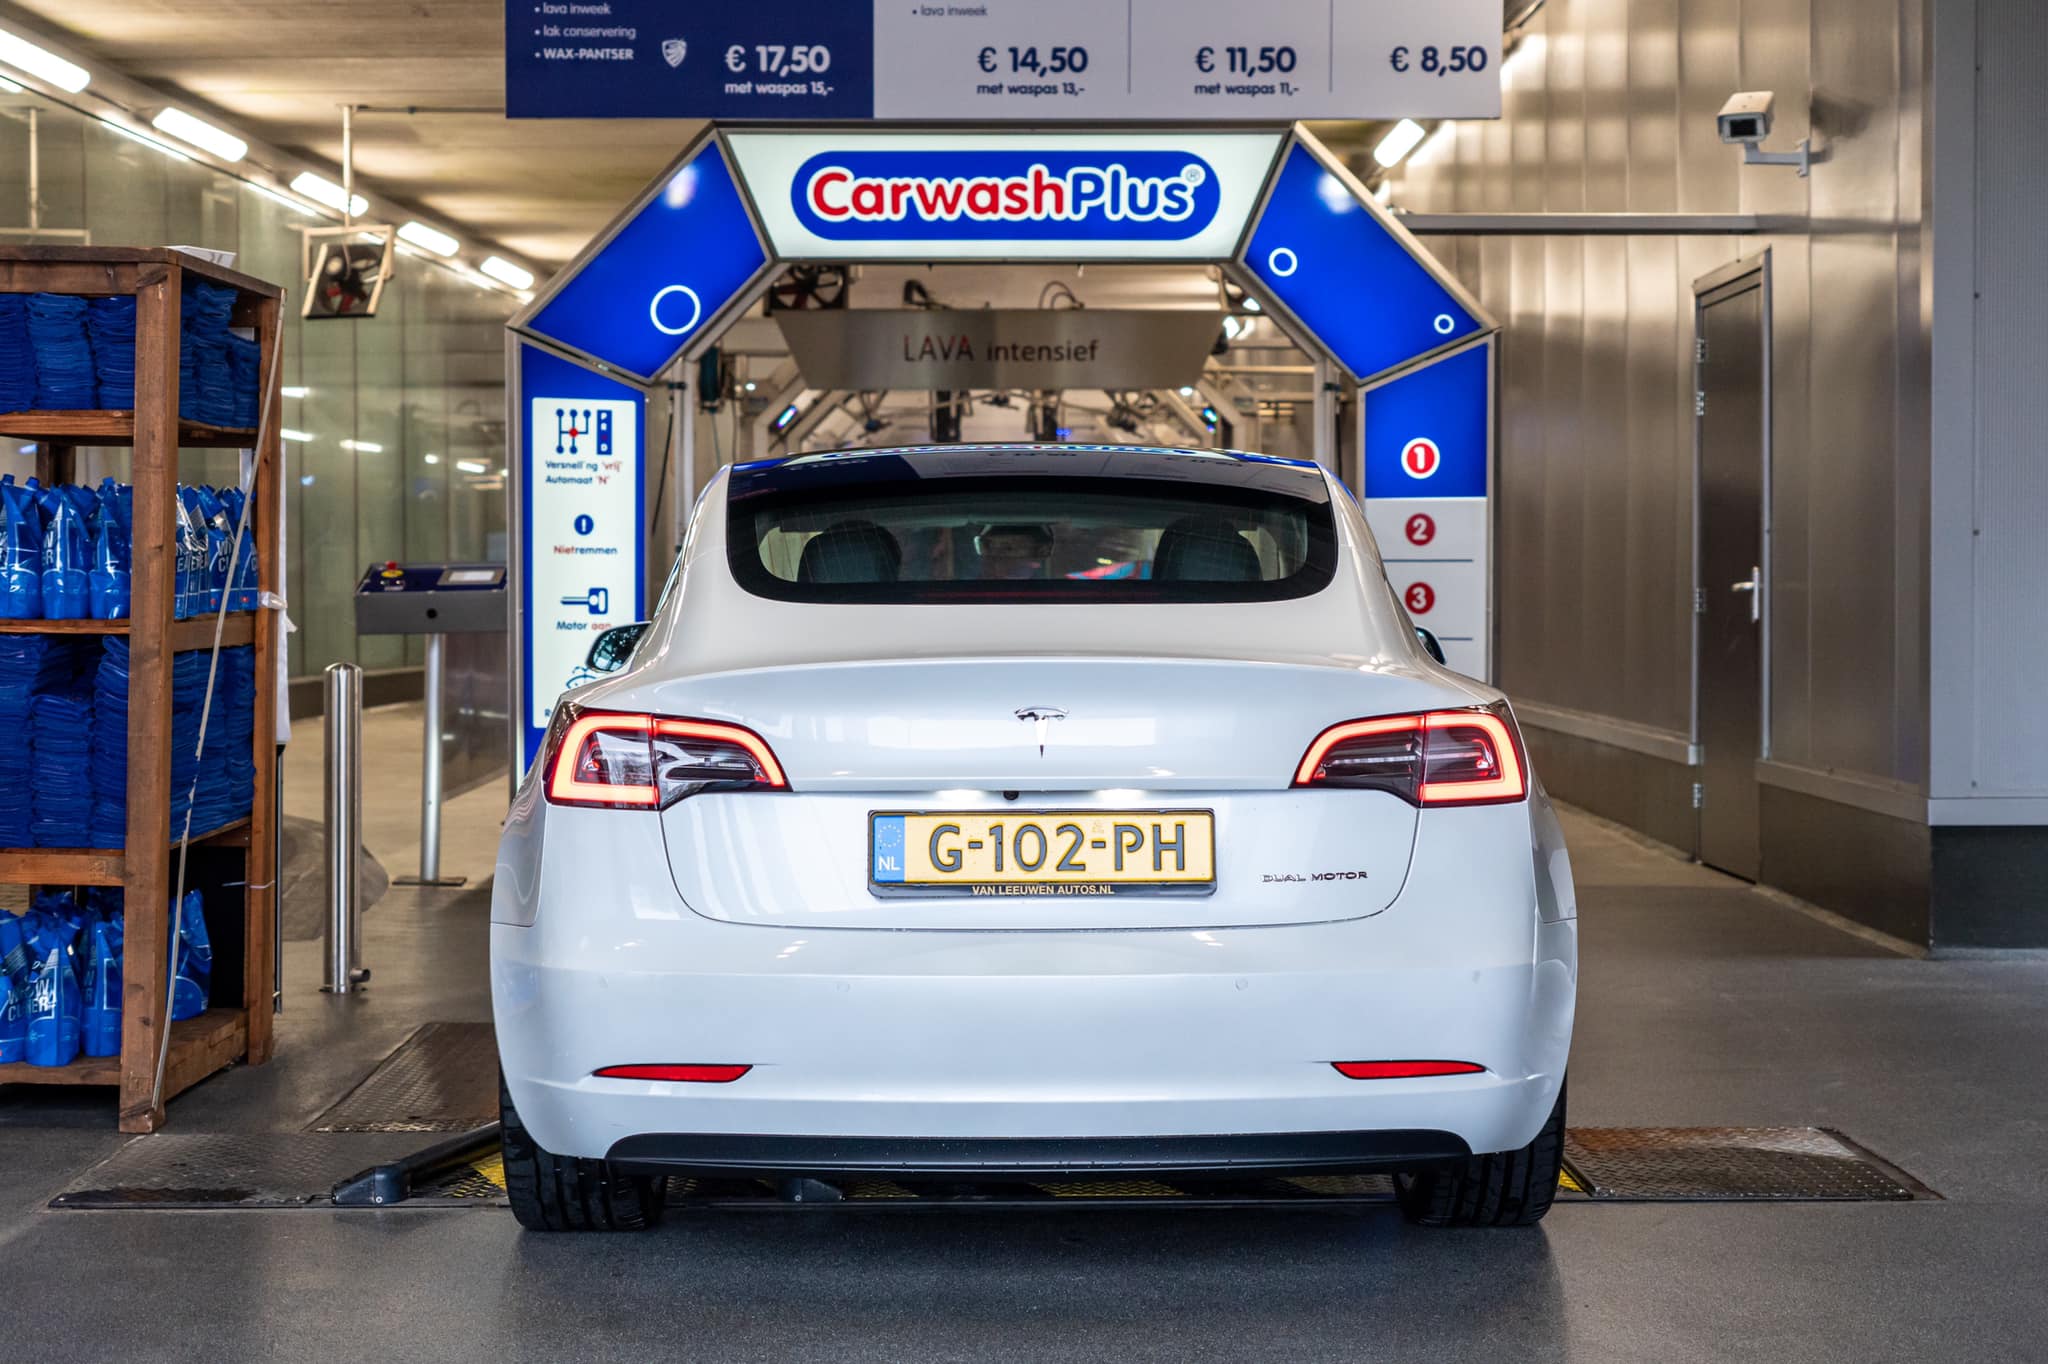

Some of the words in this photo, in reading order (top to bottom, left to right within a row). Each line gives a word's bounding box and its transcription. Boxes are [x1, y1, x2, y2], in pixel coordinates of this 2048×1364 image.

[543, 2, 568, 15] lava
[570, 2, 611, 15] inweek
[920, 5, 945, 17] lava
[948, 5, 988, 17] inweek
[543, 25, 560, 37] lak
[563, 26, 636, 40] conservering
[543, 48, 634, 60] WAX-PANTSER
[725, 45, 746, 73] €
[756, 45, 831, 77] 17,50
[977, 46, 998, 73] €
[1008, 46, 1089, 77] 14,50
[1195, 46, 1216, 73] €
[1226, 46, 1297, 77] 11,50
[1389, 46, 1410, 72] €
[1420, 46, 1488, 77] 8,50
[725, 81, 752, 94] met
[755, 83, 808, 97] waspas
[976, 83, 1004, 95] met
[1007, 84, 1058, 97] waspas
[1194, 82, 1221, 95] met
[1225, 84, 1276, 97] waspas
[903, 335, 975, 362] LAVA
[987, 340, 1099, 362] intensief
[1414, 446, 1425, 470] 1
[545, 475, 593, 485] Automaat
[1411, 518, 1428, 541] 2
[1411, 587, 1427, 609] 3
[556, 621, 588, 631] Motor
[928, 824, 1187, 873] G-102-PH
[878, 857, 901, 872] NL
[1262, 873, 1307, 883] DUAL
[1311, 871, 1369, 881] MOTOR
[972, 885, 997, 896] VAN
[998, 885, 1055, 896] LEEUWEN
[1057, 885, 1116, 896] AUTOS.NL
